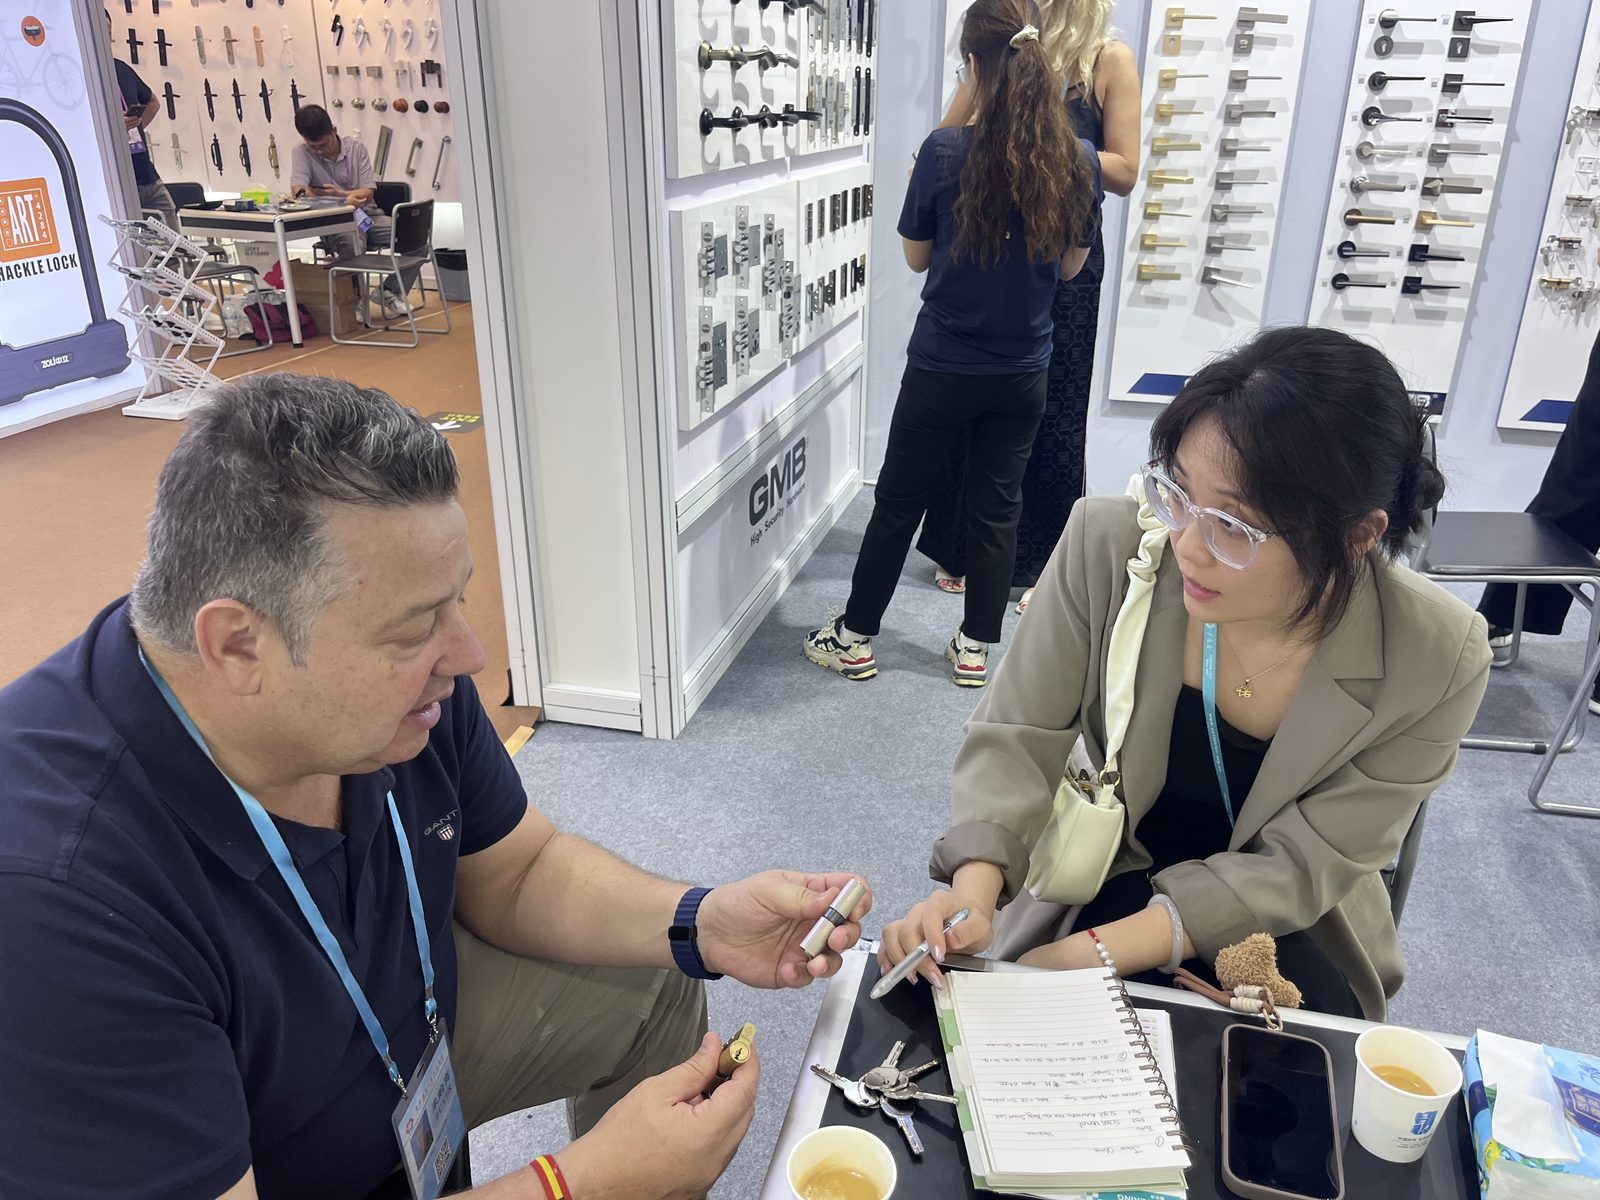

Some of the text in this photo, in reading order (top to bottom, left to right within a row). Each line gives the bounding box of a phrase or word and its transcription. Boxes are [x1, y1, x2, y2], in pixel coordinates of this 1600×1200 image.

[7, 194, 40, 245] ART
[46, 253, 78, 273] LOCK
[749, 436, 806, 526] GMB
[750, 528, 763, 547] High
[764, 507, 784, 532] Security
[424, 808, 458, 836] GANT
